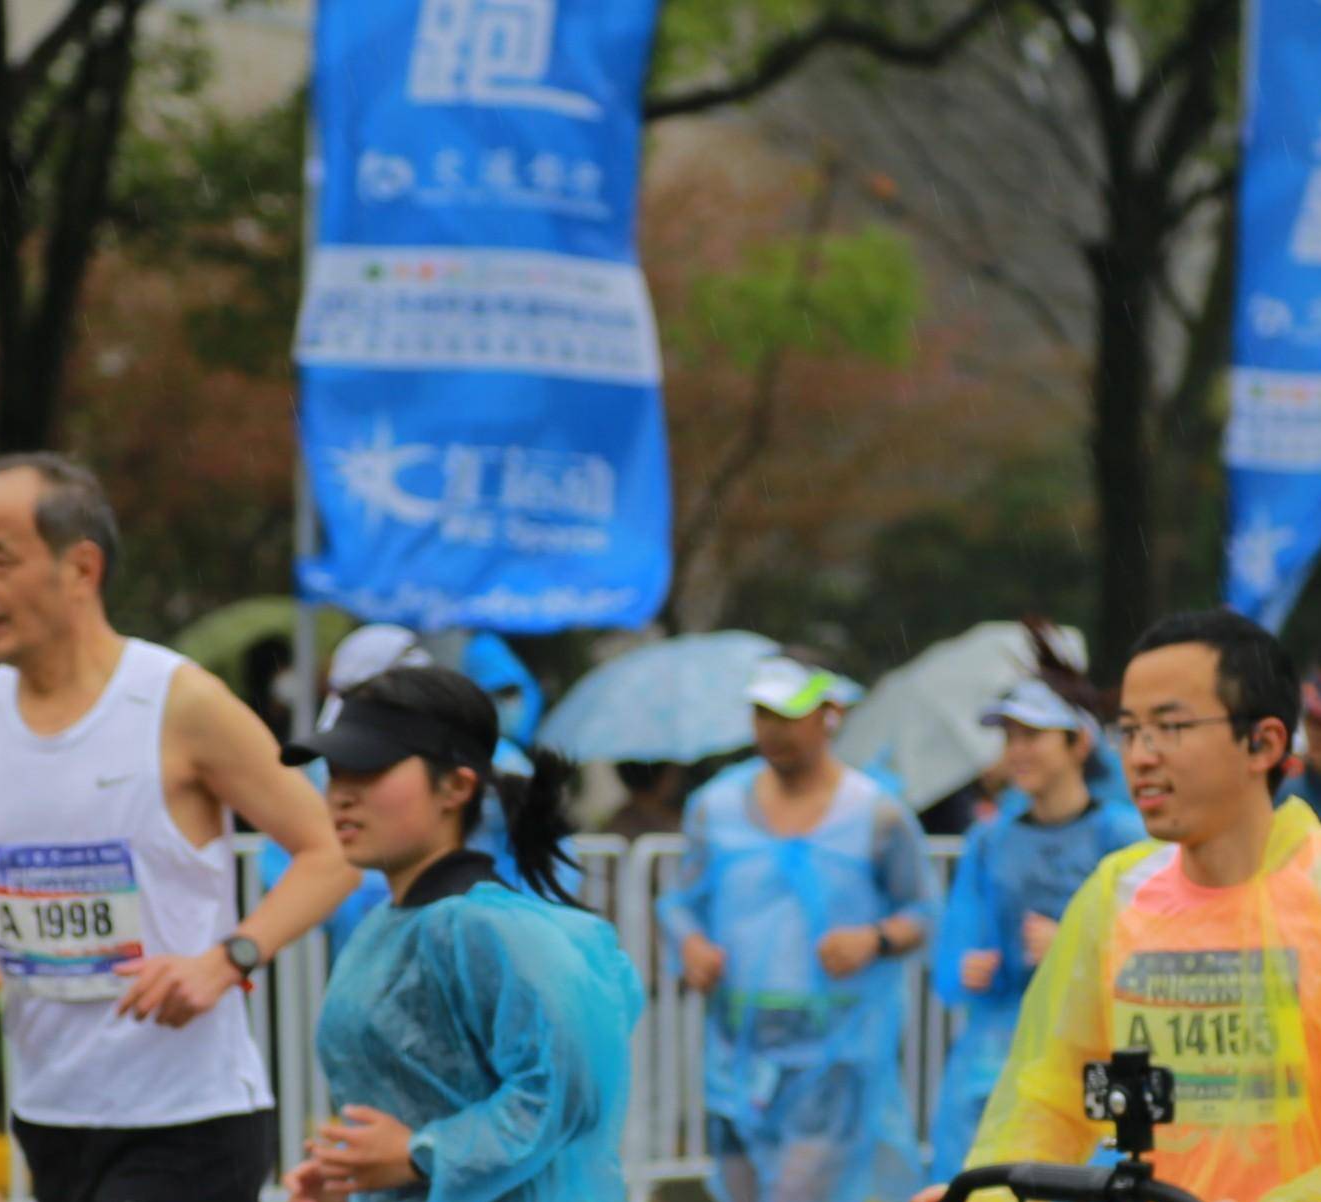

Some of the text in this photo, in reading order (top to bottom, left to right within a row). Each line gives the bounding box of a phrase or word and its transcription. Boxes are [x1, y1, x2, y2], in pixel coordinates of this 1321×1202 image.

[1, 902, 113, 940] A 1998
[1128, 1014, 1156, 1055] A
